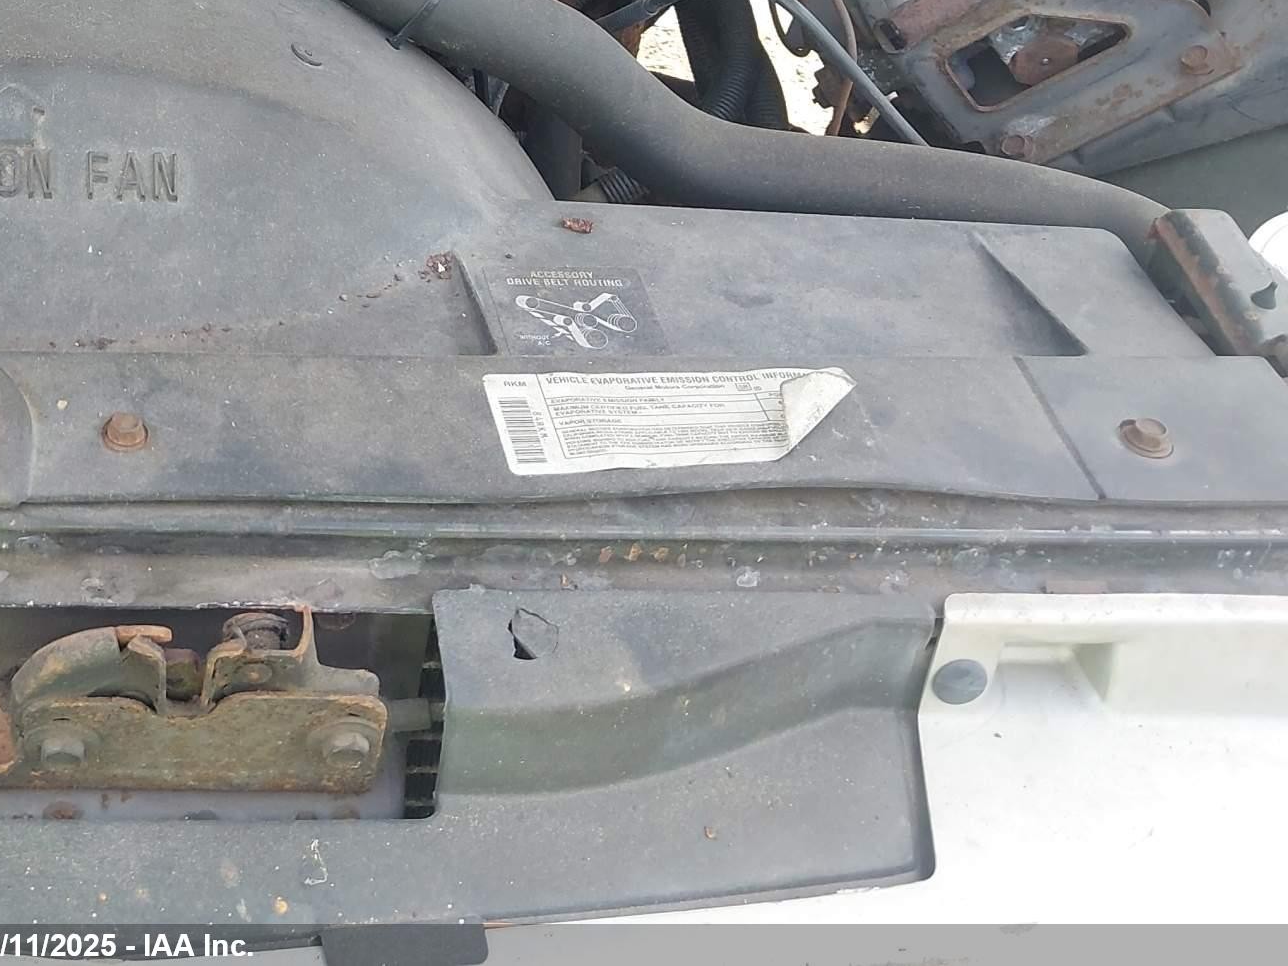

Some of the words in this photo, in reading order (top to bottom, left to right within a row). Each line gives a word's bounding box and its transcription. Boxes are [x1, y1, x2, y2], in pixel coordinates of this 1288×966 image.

[85, 150, 179, 202] FAN
[529, 270, 594, 278] ACCESSORY
[506, 277, 540, 285] DRIVE
[543, 278, 570, 286] BELT
[573, 279, 624, 287] ROUTING
[546, 376, 590, 385] VEHICLE
[590, 376, 659, 385] EVAPORATIVE
[660, 375, 711, 384] EMISSION
[712, 373, 759, 383] CONTROL
[761, 371, 808, 379] INFORM
